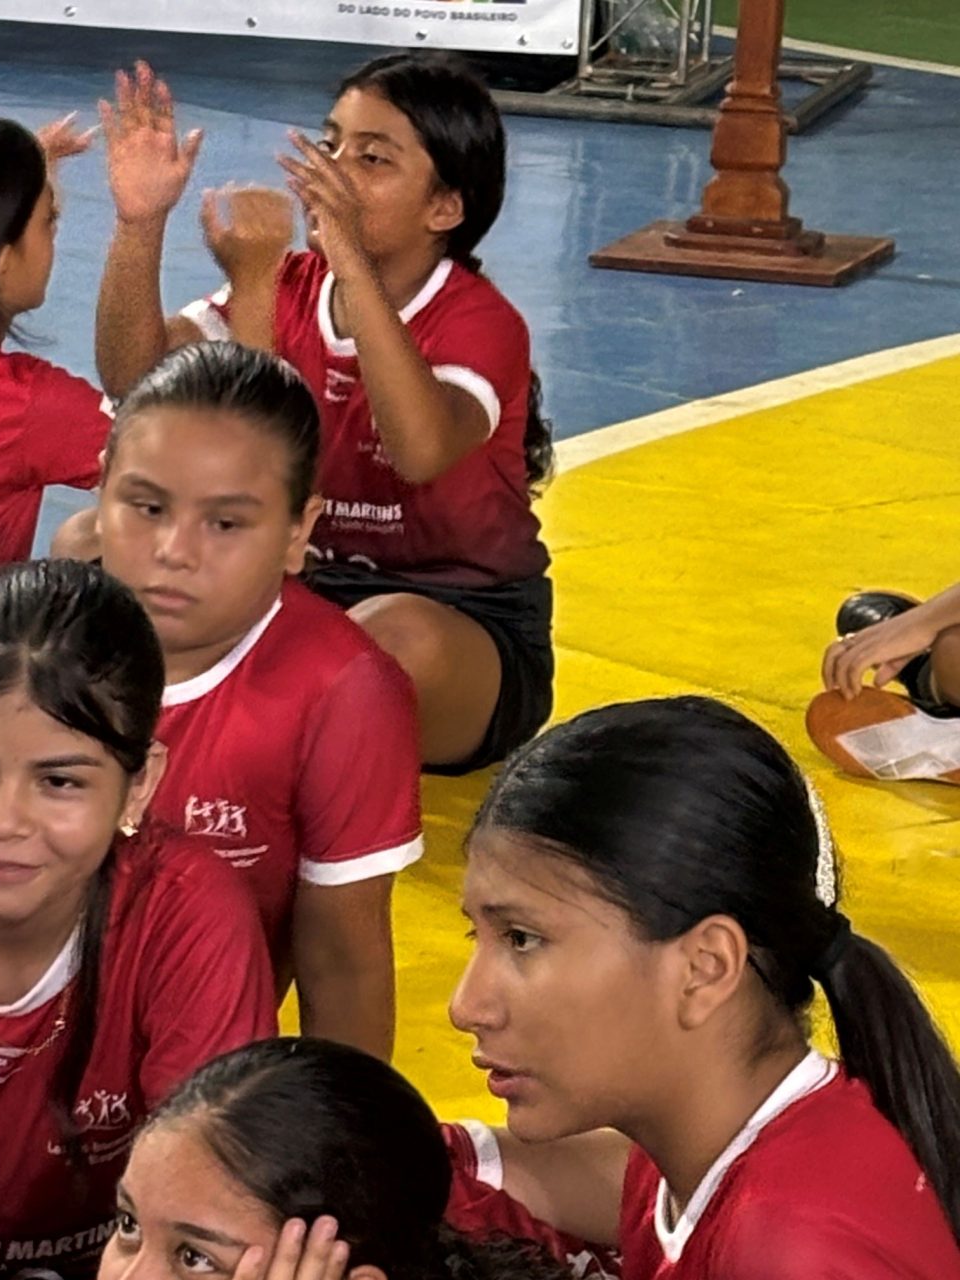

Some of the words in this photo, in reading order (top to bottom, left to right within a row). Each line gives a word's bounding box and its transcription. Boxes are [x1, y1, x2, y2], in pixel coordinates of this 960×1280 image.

[338, 4, 356, 13] DO
[359, 5, 389, 16] LADO
[393, 8, 411, 17] DO
[414, 9, 447, 19] POVO
[450, 11, 518, 22] BRASILEIRO
[6, 1213, 119, 1260] MARTIN
